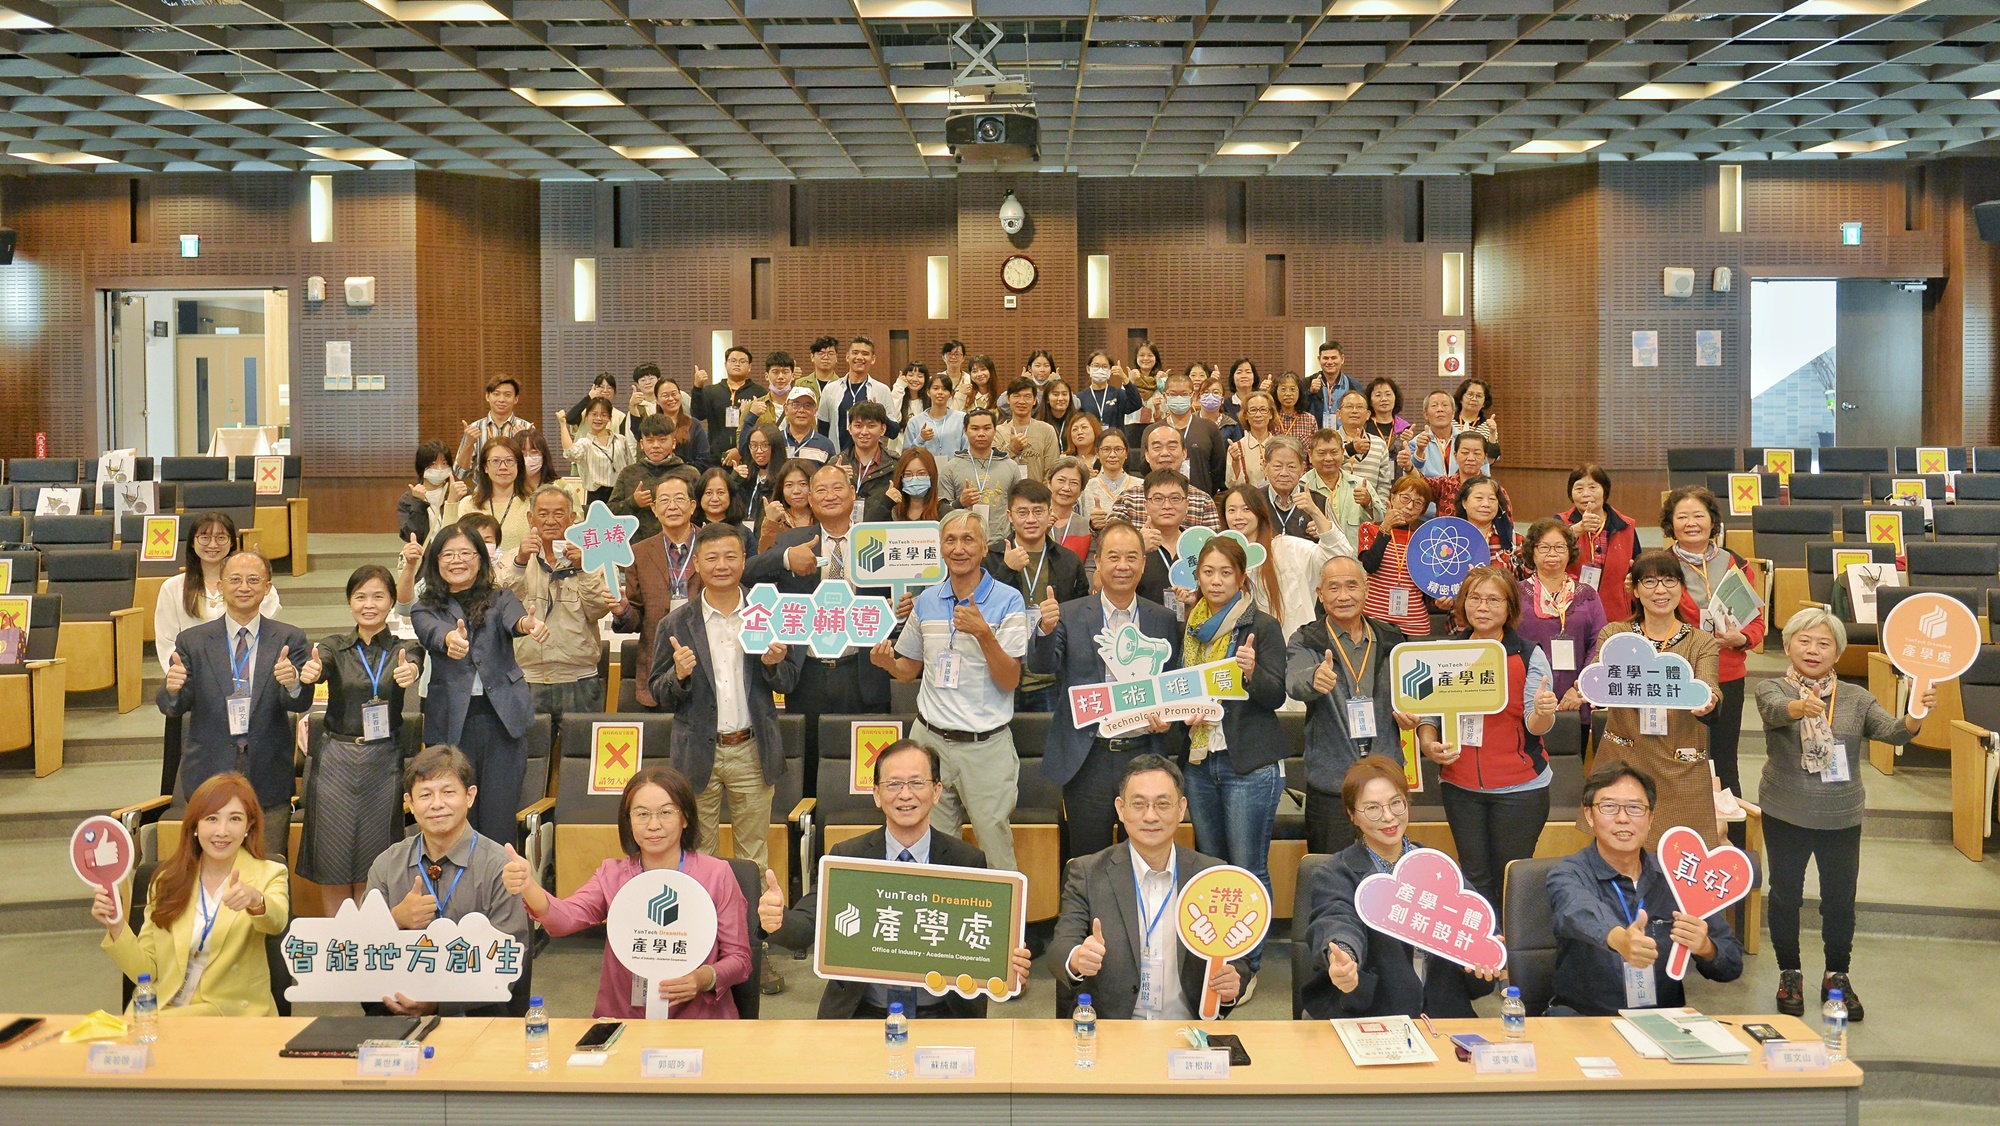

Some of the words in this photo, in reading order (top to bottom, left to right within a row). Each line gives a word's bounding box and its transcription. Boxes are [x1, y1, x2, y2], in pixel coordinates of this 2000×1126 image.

[582, 524, 626, 549] 真棒
[889, 546, 937, 561] 產學處
[742, 603, 880, 637] 企業輔導
[1902, 644, 1952, 664] 產學處
[1438, 670, 1495, 687] 產學處
[1607, 664, 1681, 680] 產學一體
[1077, 669, 1234, 715] 技術推廣
[1608, 682, 1681, 698] 創新設計
[1164, 706, 1217, 717] Promotion
[1672, 850, 1733, 900] 真好
[876, 889, 928, 902] YunTech
[931, 893, 992, 908] DreamHub
[1209, 887, 1243, 918] 讚
[1395, 882, 1483, 931] 產學一體
[871, 905, 992, 951] 產學處
[1388, 904, 1475, 952] 創新設計
[285, 935, 520, 974] 智能地方創生
[632, 938, 687, 955] 產學處
[871, 946, 890, 954] Office
[897, 949, 921, 958] Industry
[926, 951, 954, 959] Academia
[955, 953, 991, 963] Cooperation
[1634, 971, 1644, 999] 張文山
[1784, 1053, 1812, 1063] 張文山
